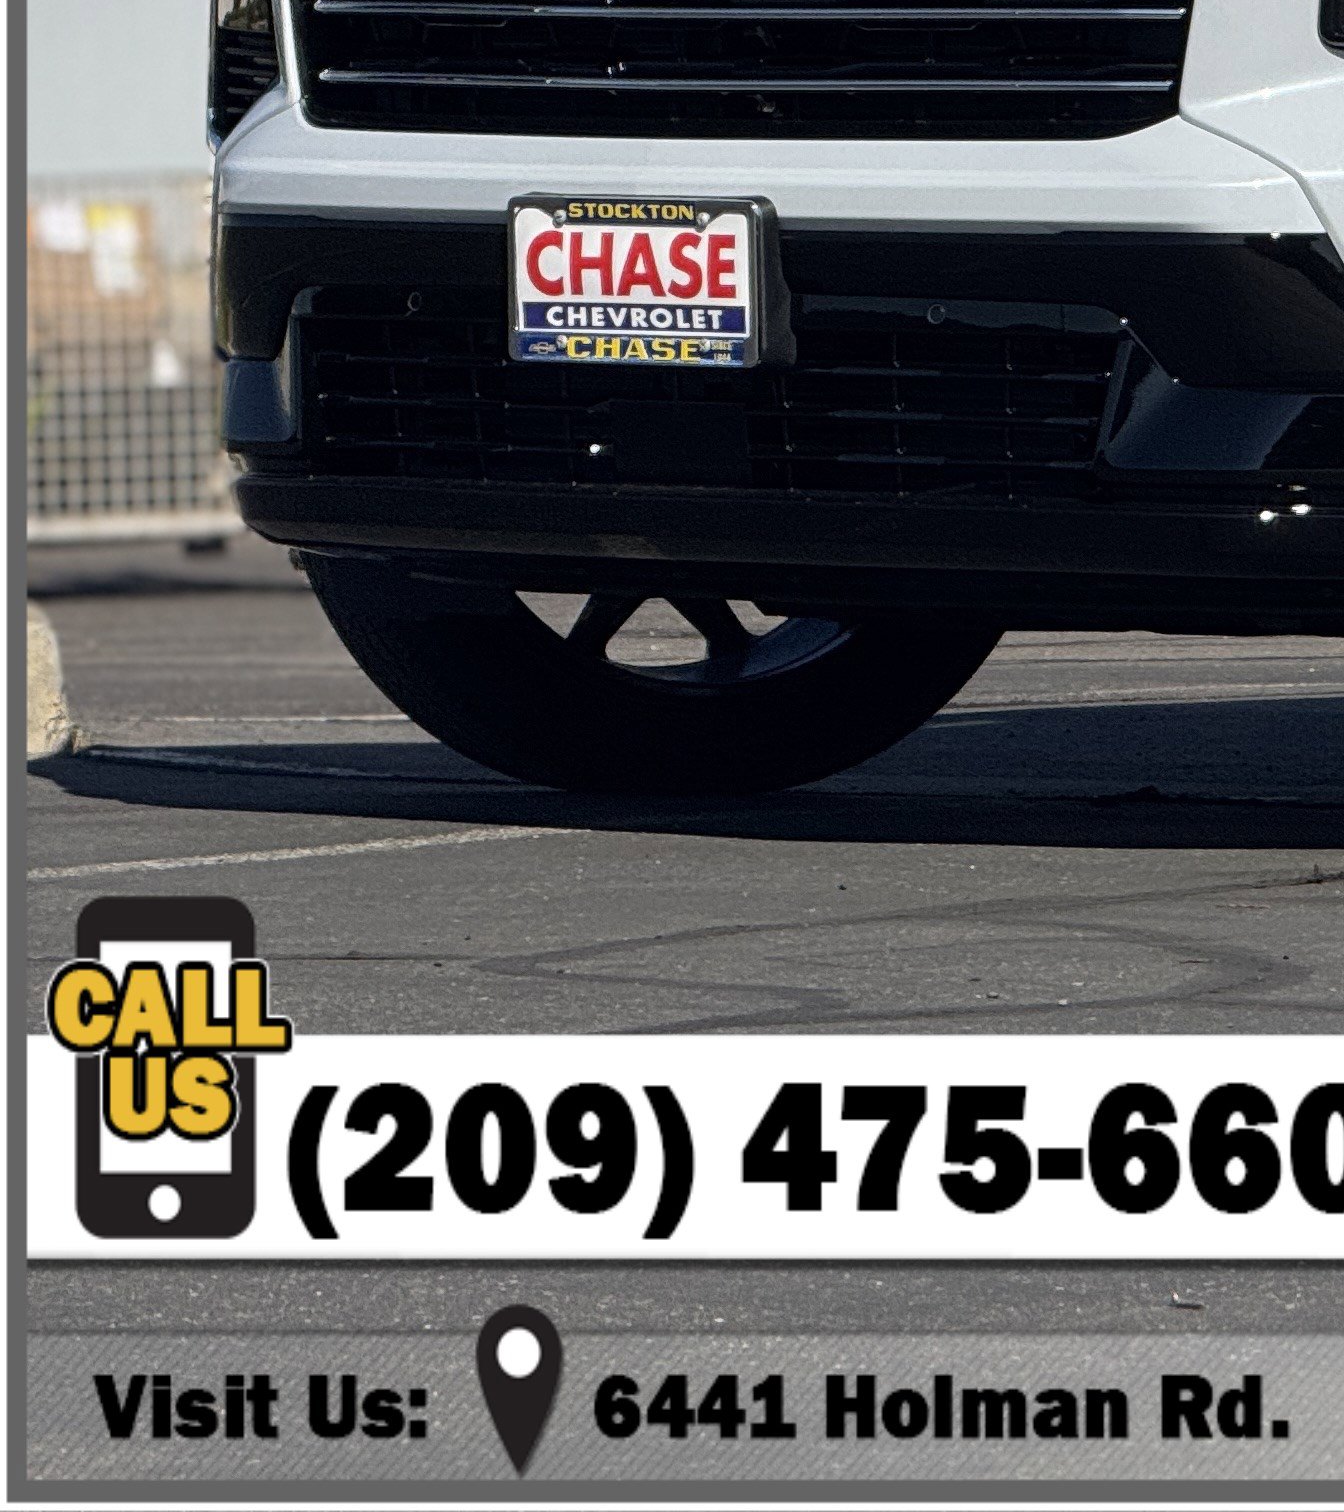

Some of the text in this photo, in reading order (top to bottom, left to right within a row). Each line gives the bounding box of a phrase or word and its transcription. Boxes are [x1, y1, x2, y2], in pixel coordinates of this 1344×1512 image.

[567, 201, 695, 222] STOCKTON
[525, 230, 738, 299] CHASE
[545, 304, 724, 331] CHEVROLET
[566, 335, 701, 363] CHASE
